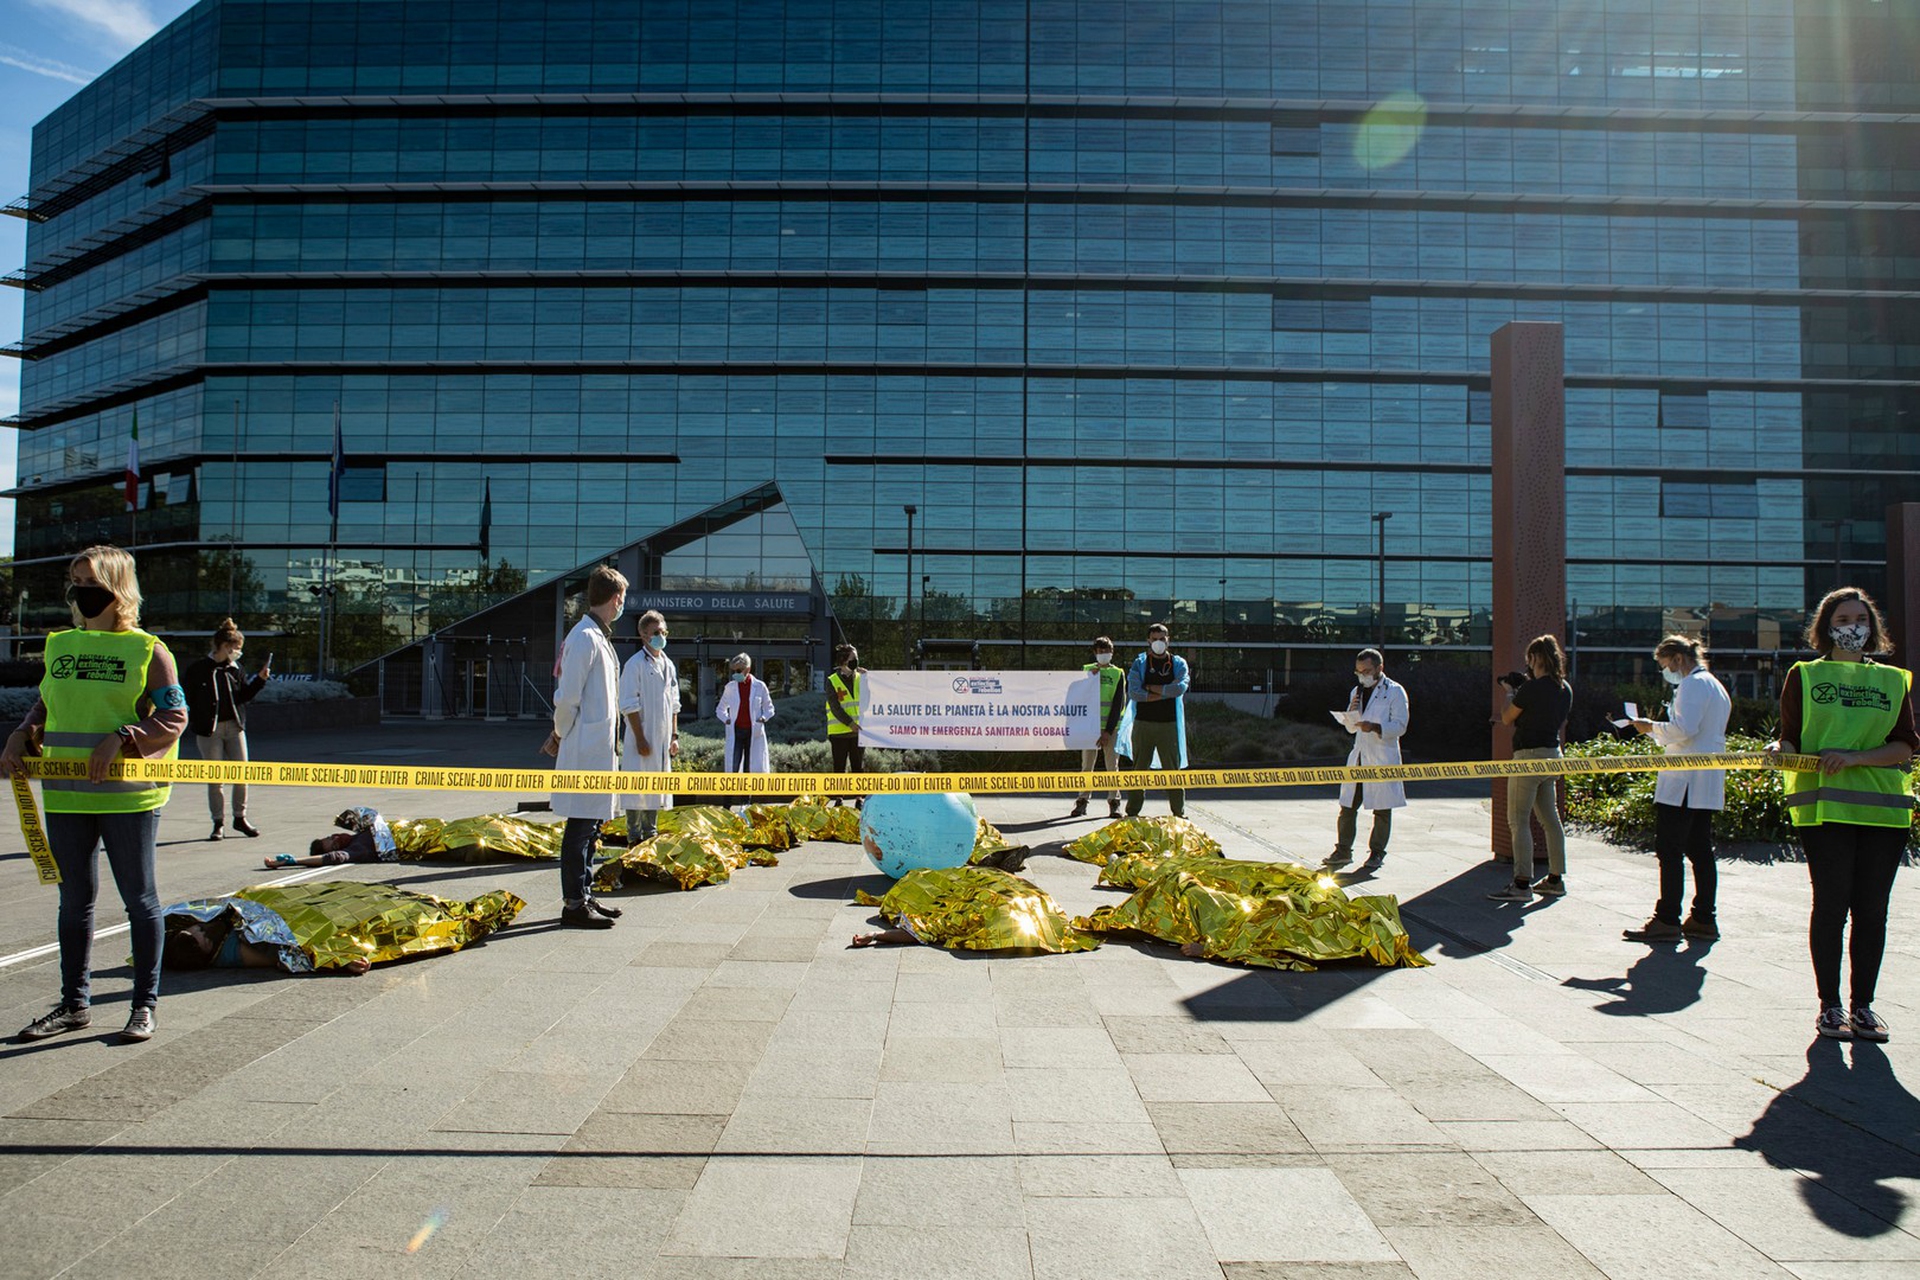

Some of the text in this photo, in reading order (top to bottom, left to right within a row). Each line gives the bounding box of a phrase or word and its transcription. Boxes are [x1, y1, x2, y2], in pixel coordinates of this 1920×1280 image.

[642, 597, 795, 609] MINISTERO DELLA SALUTE
[78, 660, 118, 670] extinction
[86, 671, 124, 681] rebellion
[1840, 689, 1881, 699] extinction
[872, 702, 1088, 716] LA SALUTE DEL PIANETA È LA NOSTRA SALUTE
[889, 725, 1070, 736] SIAMO IN EMERGENZA SANITARIA GLOBALE
[1473, 760, 1593, 775] CRIME SCENE-DO NOT ENTER
[1596, 755, 1713, 770] CRIME SCENE-DO NOT ENTER
[1715, 755, 1745, 766] CRIME
[1784, 755, 1798, 768] NOT
[43, 762, 87, 777] SCENE-DO
[109, 762, 138, 777] ENTER
[144, 763, 273, 781] CRIME SCENE-DO NOT ENTER
[279, 767, 409, 785] CRIME SCENE-DO NOT ENTER
[1349, 765, 1470, 780] CRIME SCENE-DO NOT ENTER
[415, 771, 544, 789] CRIME SCENE-DO NOT ENTER
[551, 774, 681, 791] CRIME SCENE-DO NOT ENTER
[687, 776, 817, 792] CRIME SCENE-DO NOT ENTER
[823, 777, 952, 791] CRIME SCENE-DO NOT ENTER
[959, 775, 1086, 790] CRIME SCENE-DO NOT ENTER
[1092, 773, 1217, 788] CRIME SCENE-DO NOT ENTER
[1222, 770, 1345, 785] CRIME SCENE-DO NOT ENTER
[17, 793, 34, 811] NOT
[23, 813, 47, 853] SCENE-DO
[36, 854, 57, 881] CRIME
